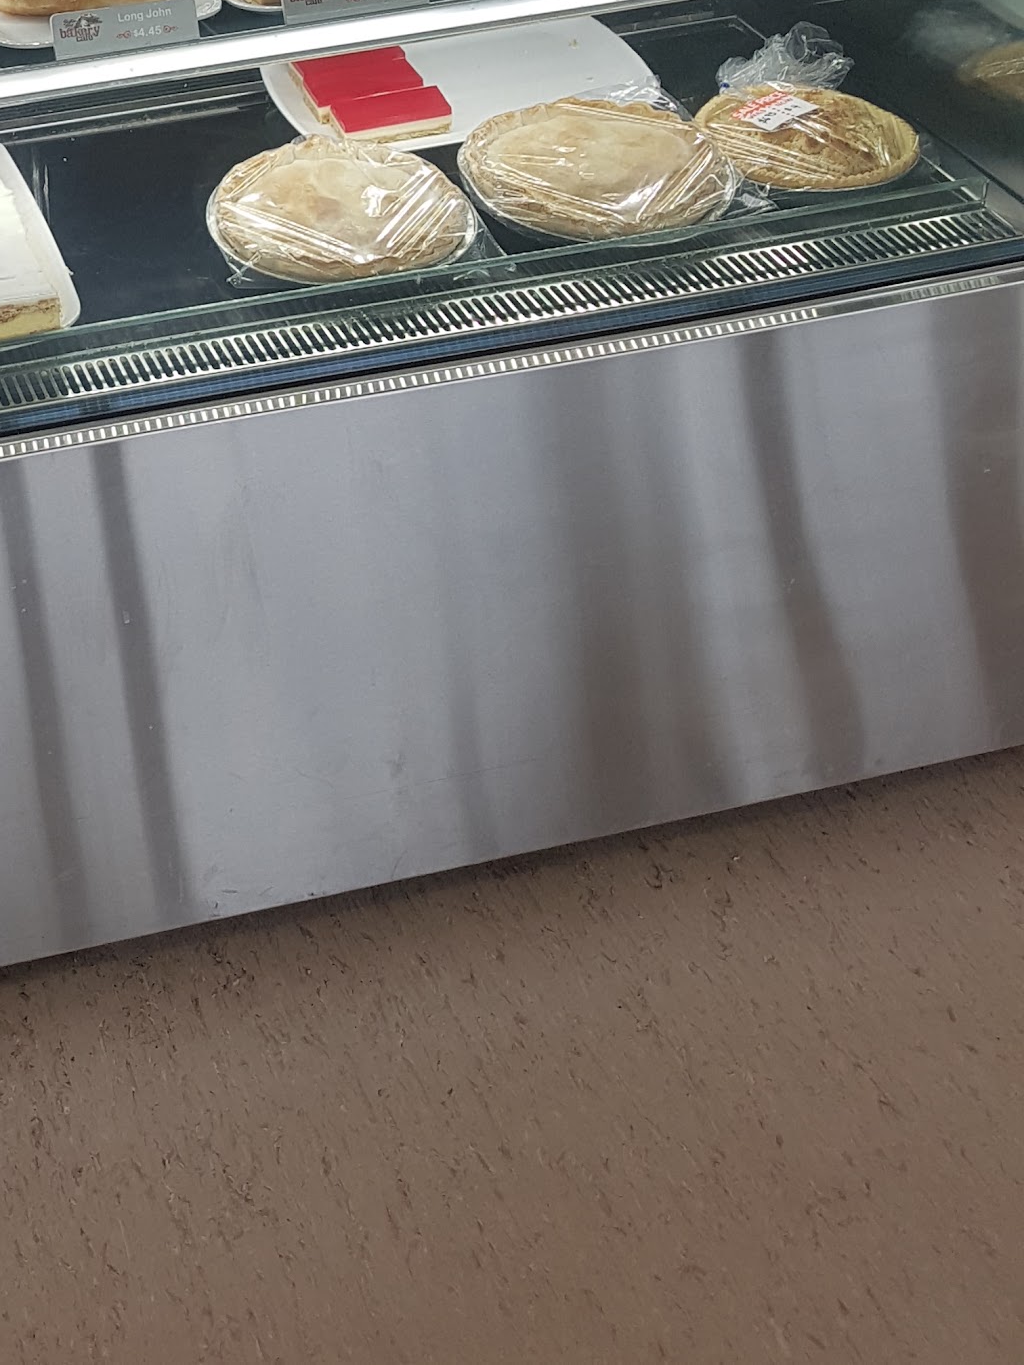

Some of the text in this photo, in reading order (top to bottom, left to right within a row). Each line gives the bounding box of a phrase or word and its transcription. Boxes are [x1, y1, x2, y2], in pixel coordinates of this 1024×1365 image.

[117, 7, 172, 23] Long John
[133, 25, 162, 37] $4.45
